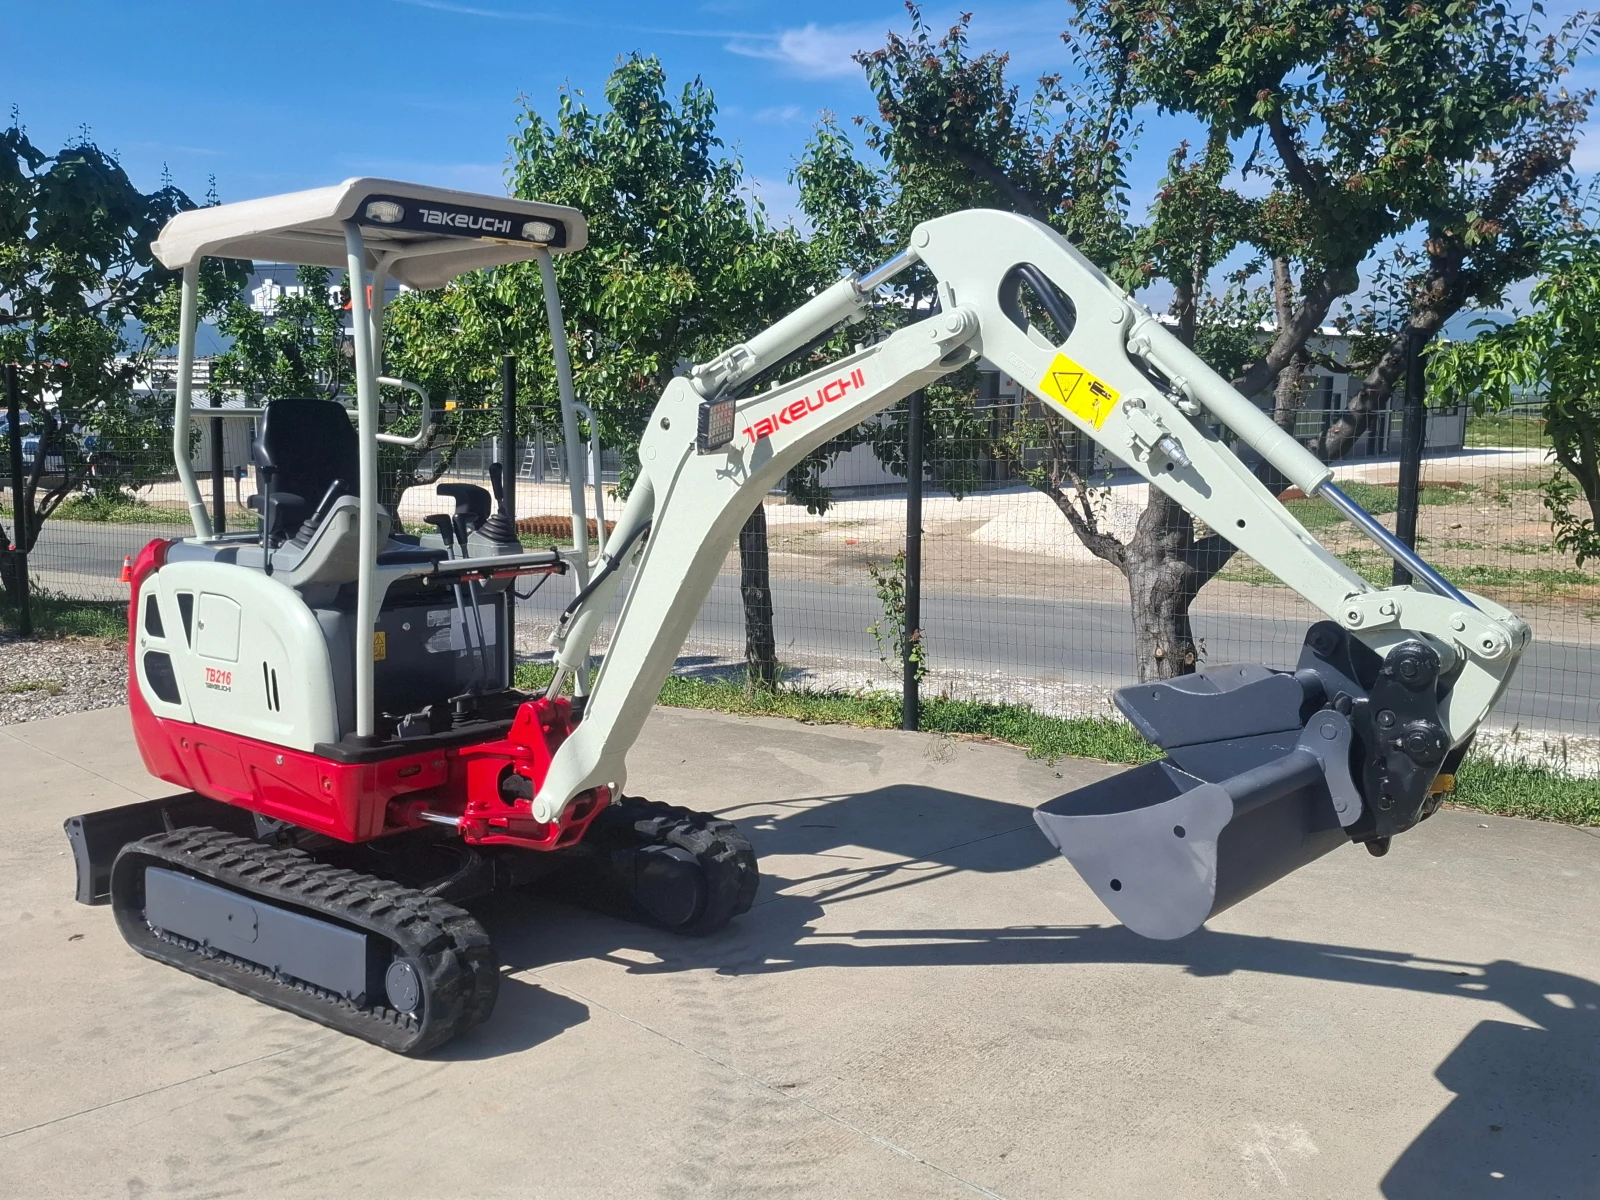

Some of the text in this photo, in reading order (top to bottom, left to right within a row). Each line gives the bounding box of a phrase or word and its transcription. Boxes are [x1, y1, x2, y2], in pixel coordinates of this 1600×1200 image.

[418, 208, 512, 233] TAKEUCHI
[741, 368, 865, 443] TAKEUCHI
[205, 667, 232, 685] TB216
